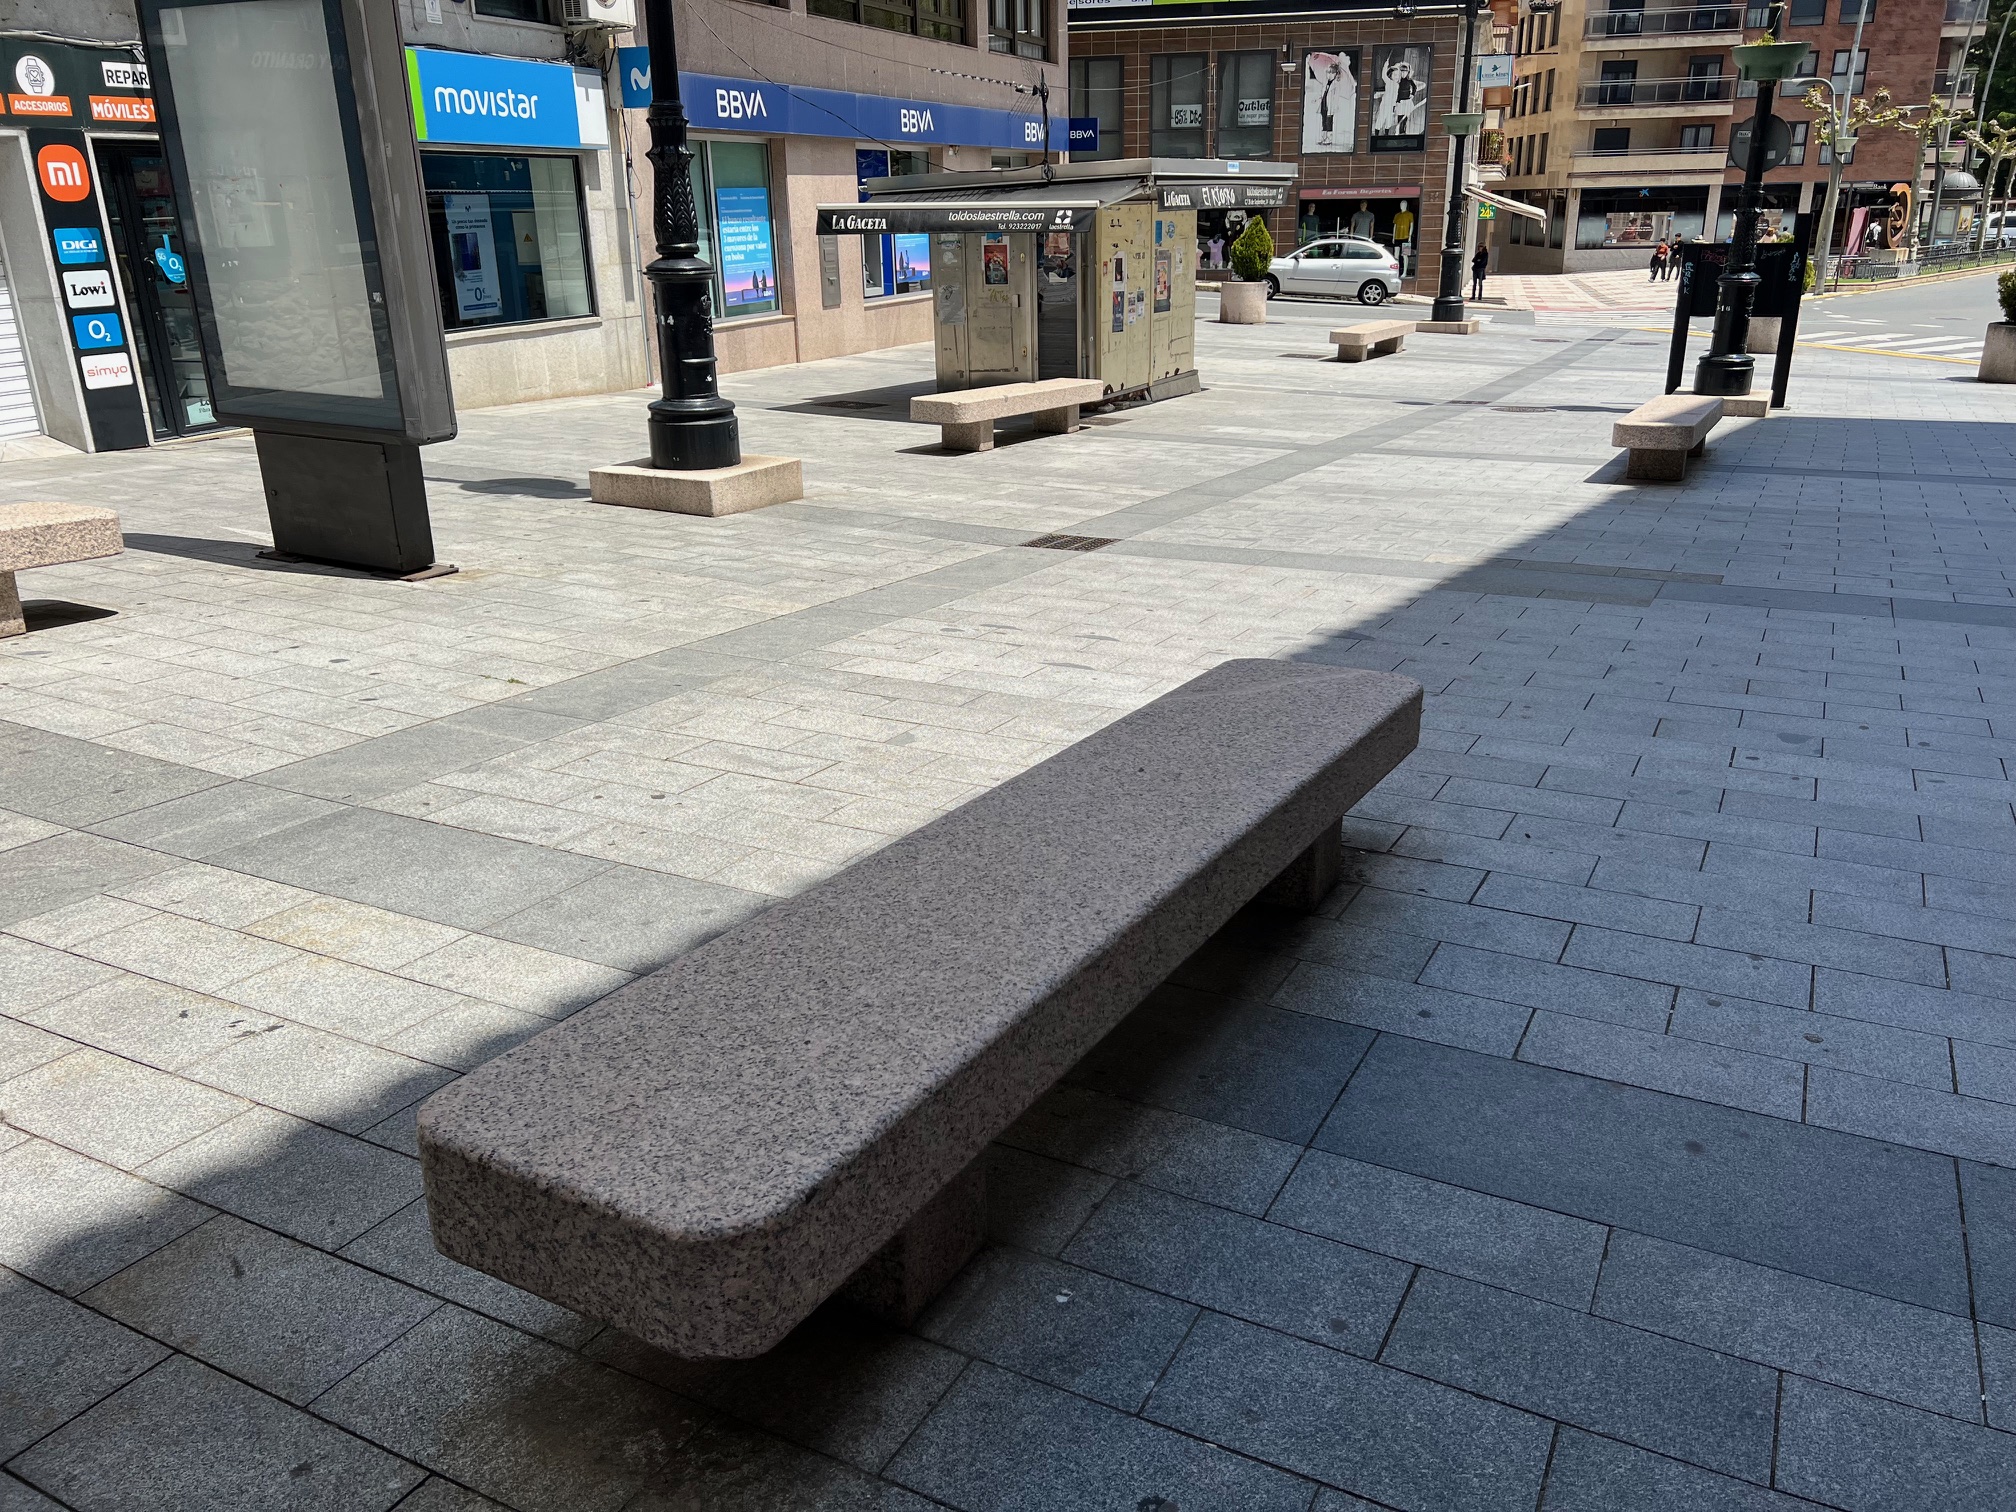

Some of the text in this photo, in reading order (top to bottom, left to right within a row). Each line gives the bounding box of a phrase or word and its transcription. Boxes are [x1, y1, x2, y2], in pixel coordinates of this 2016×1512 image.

[14, 100, 68, 112] ACCESORIOS
[92, 98, 150, 119] MÓVILES
[434, 86, 539, 120] movistar
[716, 88, 768, 120] BBVA
[1238, 100, 1270, 111] Outlet
[900, 108, 935, 133] BBVA
[1069, 129, 1096, 140] BBVA
[832, 210, 1045, 230] LA GACETA toldoslaestrella.com
[1008, 222, 1042, 230] 923222017
[61, 239, 98, 250] DIGI
[70, 280, 107, 297] Lowi
[86, 363, 128, 378] simyo
